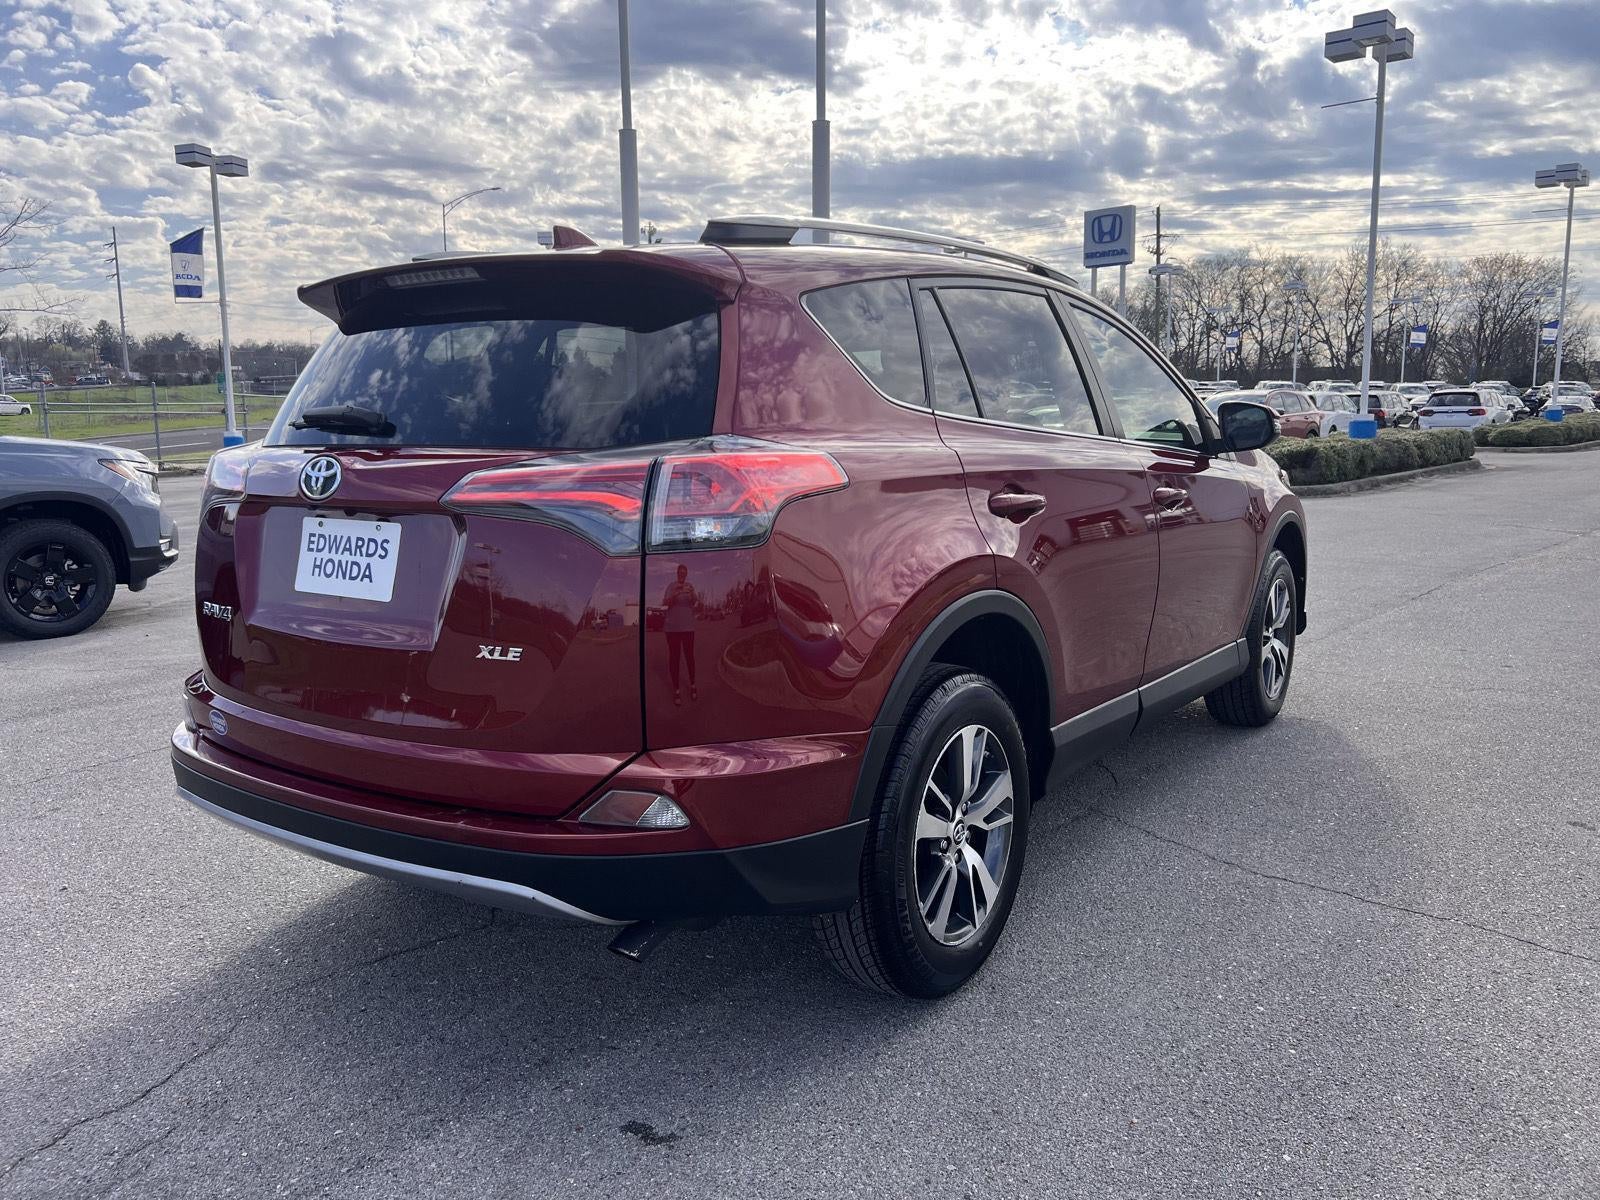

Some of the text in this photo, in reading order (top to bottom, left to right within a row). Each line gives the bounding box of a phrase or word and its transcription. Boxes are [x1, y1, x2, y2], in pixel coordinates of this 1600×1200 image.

[1084, 248, 1129, 259] HONDA
[306, 532, 390, 560] EDWARDS
[311, 557, 373, 583] HONDA
[202, 601, 232, 622] RAV4
[475, 644, 523, 661] XLE
